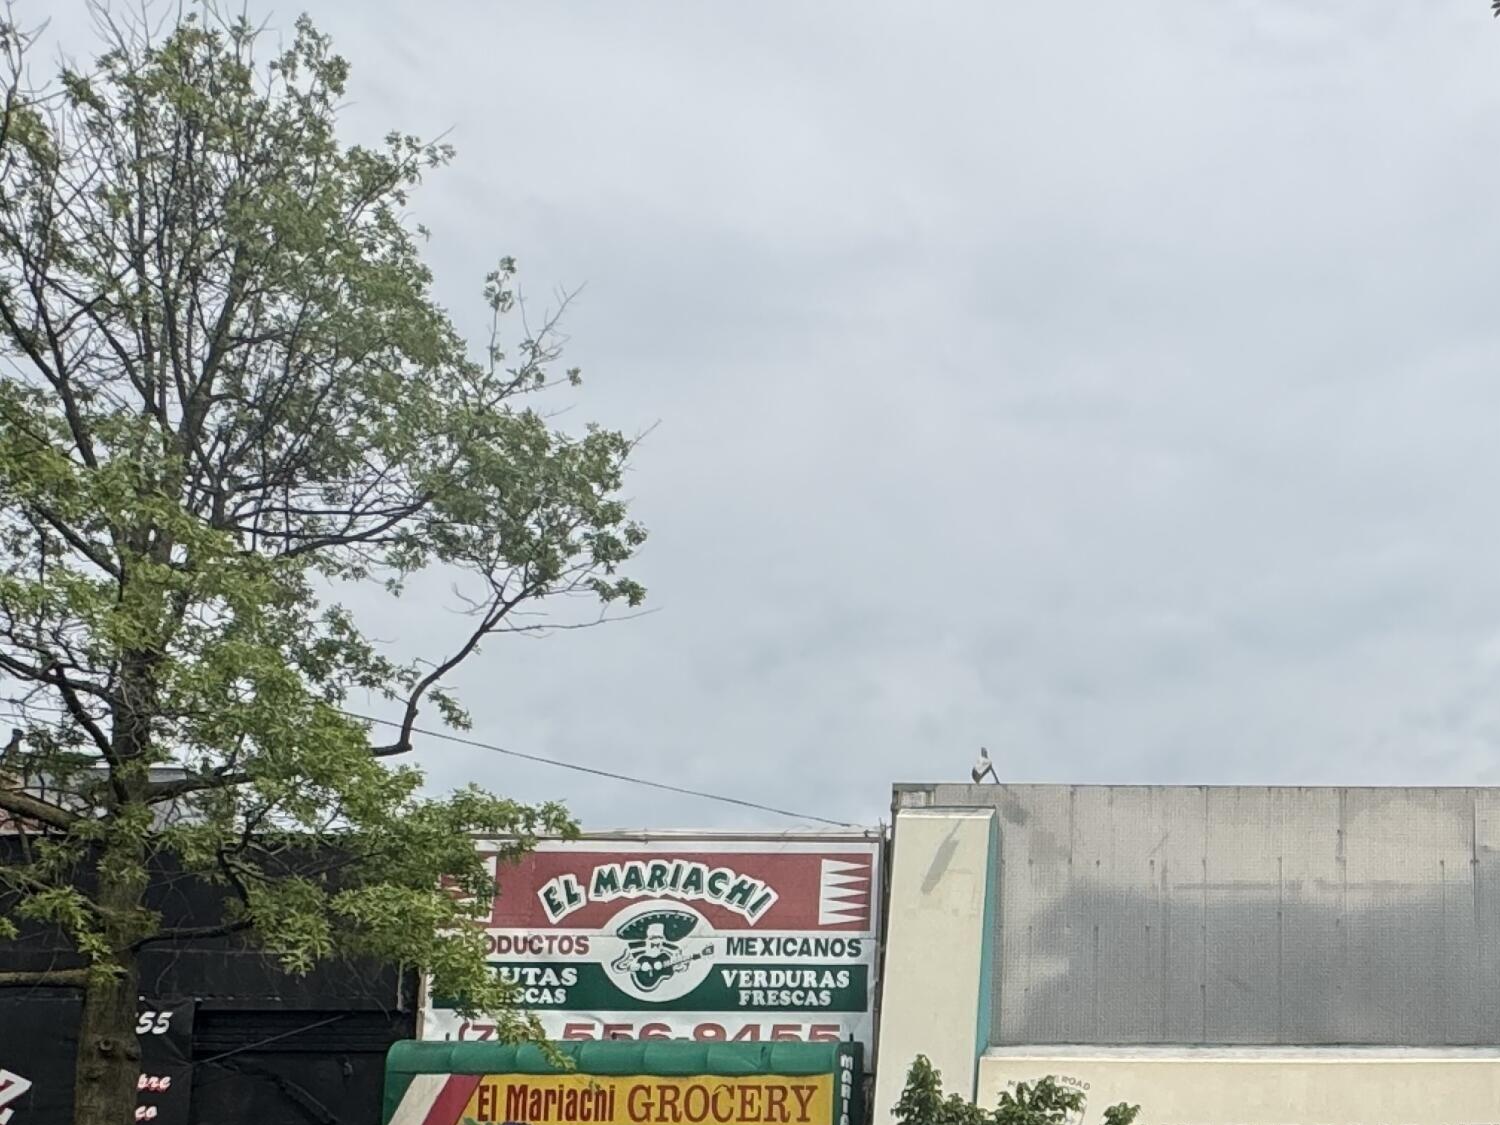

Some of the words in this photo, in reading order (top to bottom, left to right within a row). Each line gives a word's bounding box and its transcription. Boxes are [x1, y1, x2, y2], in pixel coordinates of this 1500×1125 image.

[541, 875, 586, 921] EL
[590, 860, 778, 922] MARIACHI
[484, 934, 590, 955] ODUCTOS
[725, 936, 863, 958] MEXICANOS
[484, 966, 578, 987] RUTAS
[720, 968, 850, 989] VERDURAS
[738, 989, 831, 1006] FRESCAS
[135, 1011, 173, 1035] 55
[1061, 1075, 1091, 1091] ROAD
[476, 1084, 497, 1122] El
[504, 1083, 616, 1123] Mariachi
[626, 1083, 819, 1124] GROCERY
